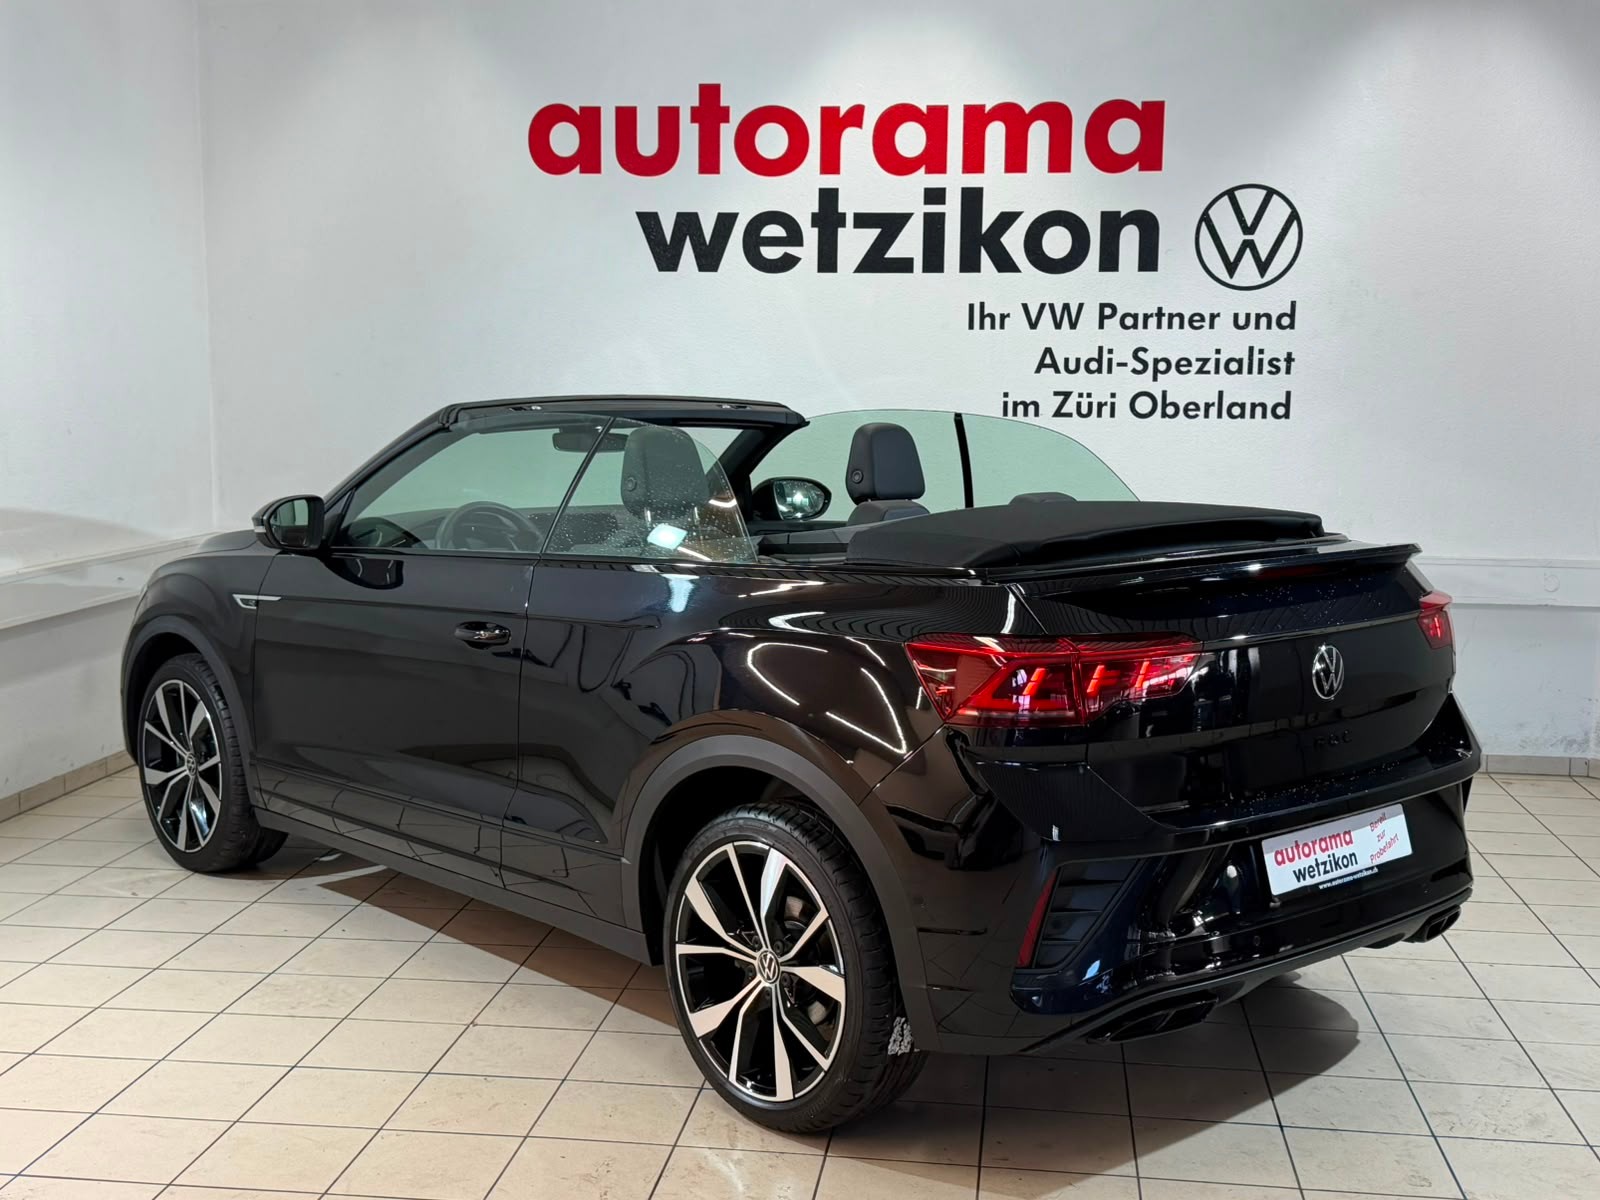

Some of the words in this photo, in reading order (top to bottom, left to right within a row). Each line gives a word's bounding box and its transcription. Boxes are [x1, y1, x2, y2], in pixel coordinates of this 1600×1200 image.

[528, 83, 1166, 177] autorama
[635, 187, 1160, 274] wetzikon
[1195, 184, 1303, 291] VW
[968, 302, 1011, 330] Ihr
[1020, 302, 1085, 330] VW
[1098, 302, 1221, 331] Partner
[1232, 300, 1297, 331] und
[1034, 345, 1296, 382] Audi-Spezialist
[1002, 391, 1040, 419] im
[1051, 390, 1117, 419] Züri
[1129, 389, 1292, 420] Oberland
[1274, 829, 1353, 866] autorama
[1370, 833, 1399, 864] Probefahrt
[1376, 829, 1386, 842] zur
[1293, 851, 1358, 883] wetzikon
